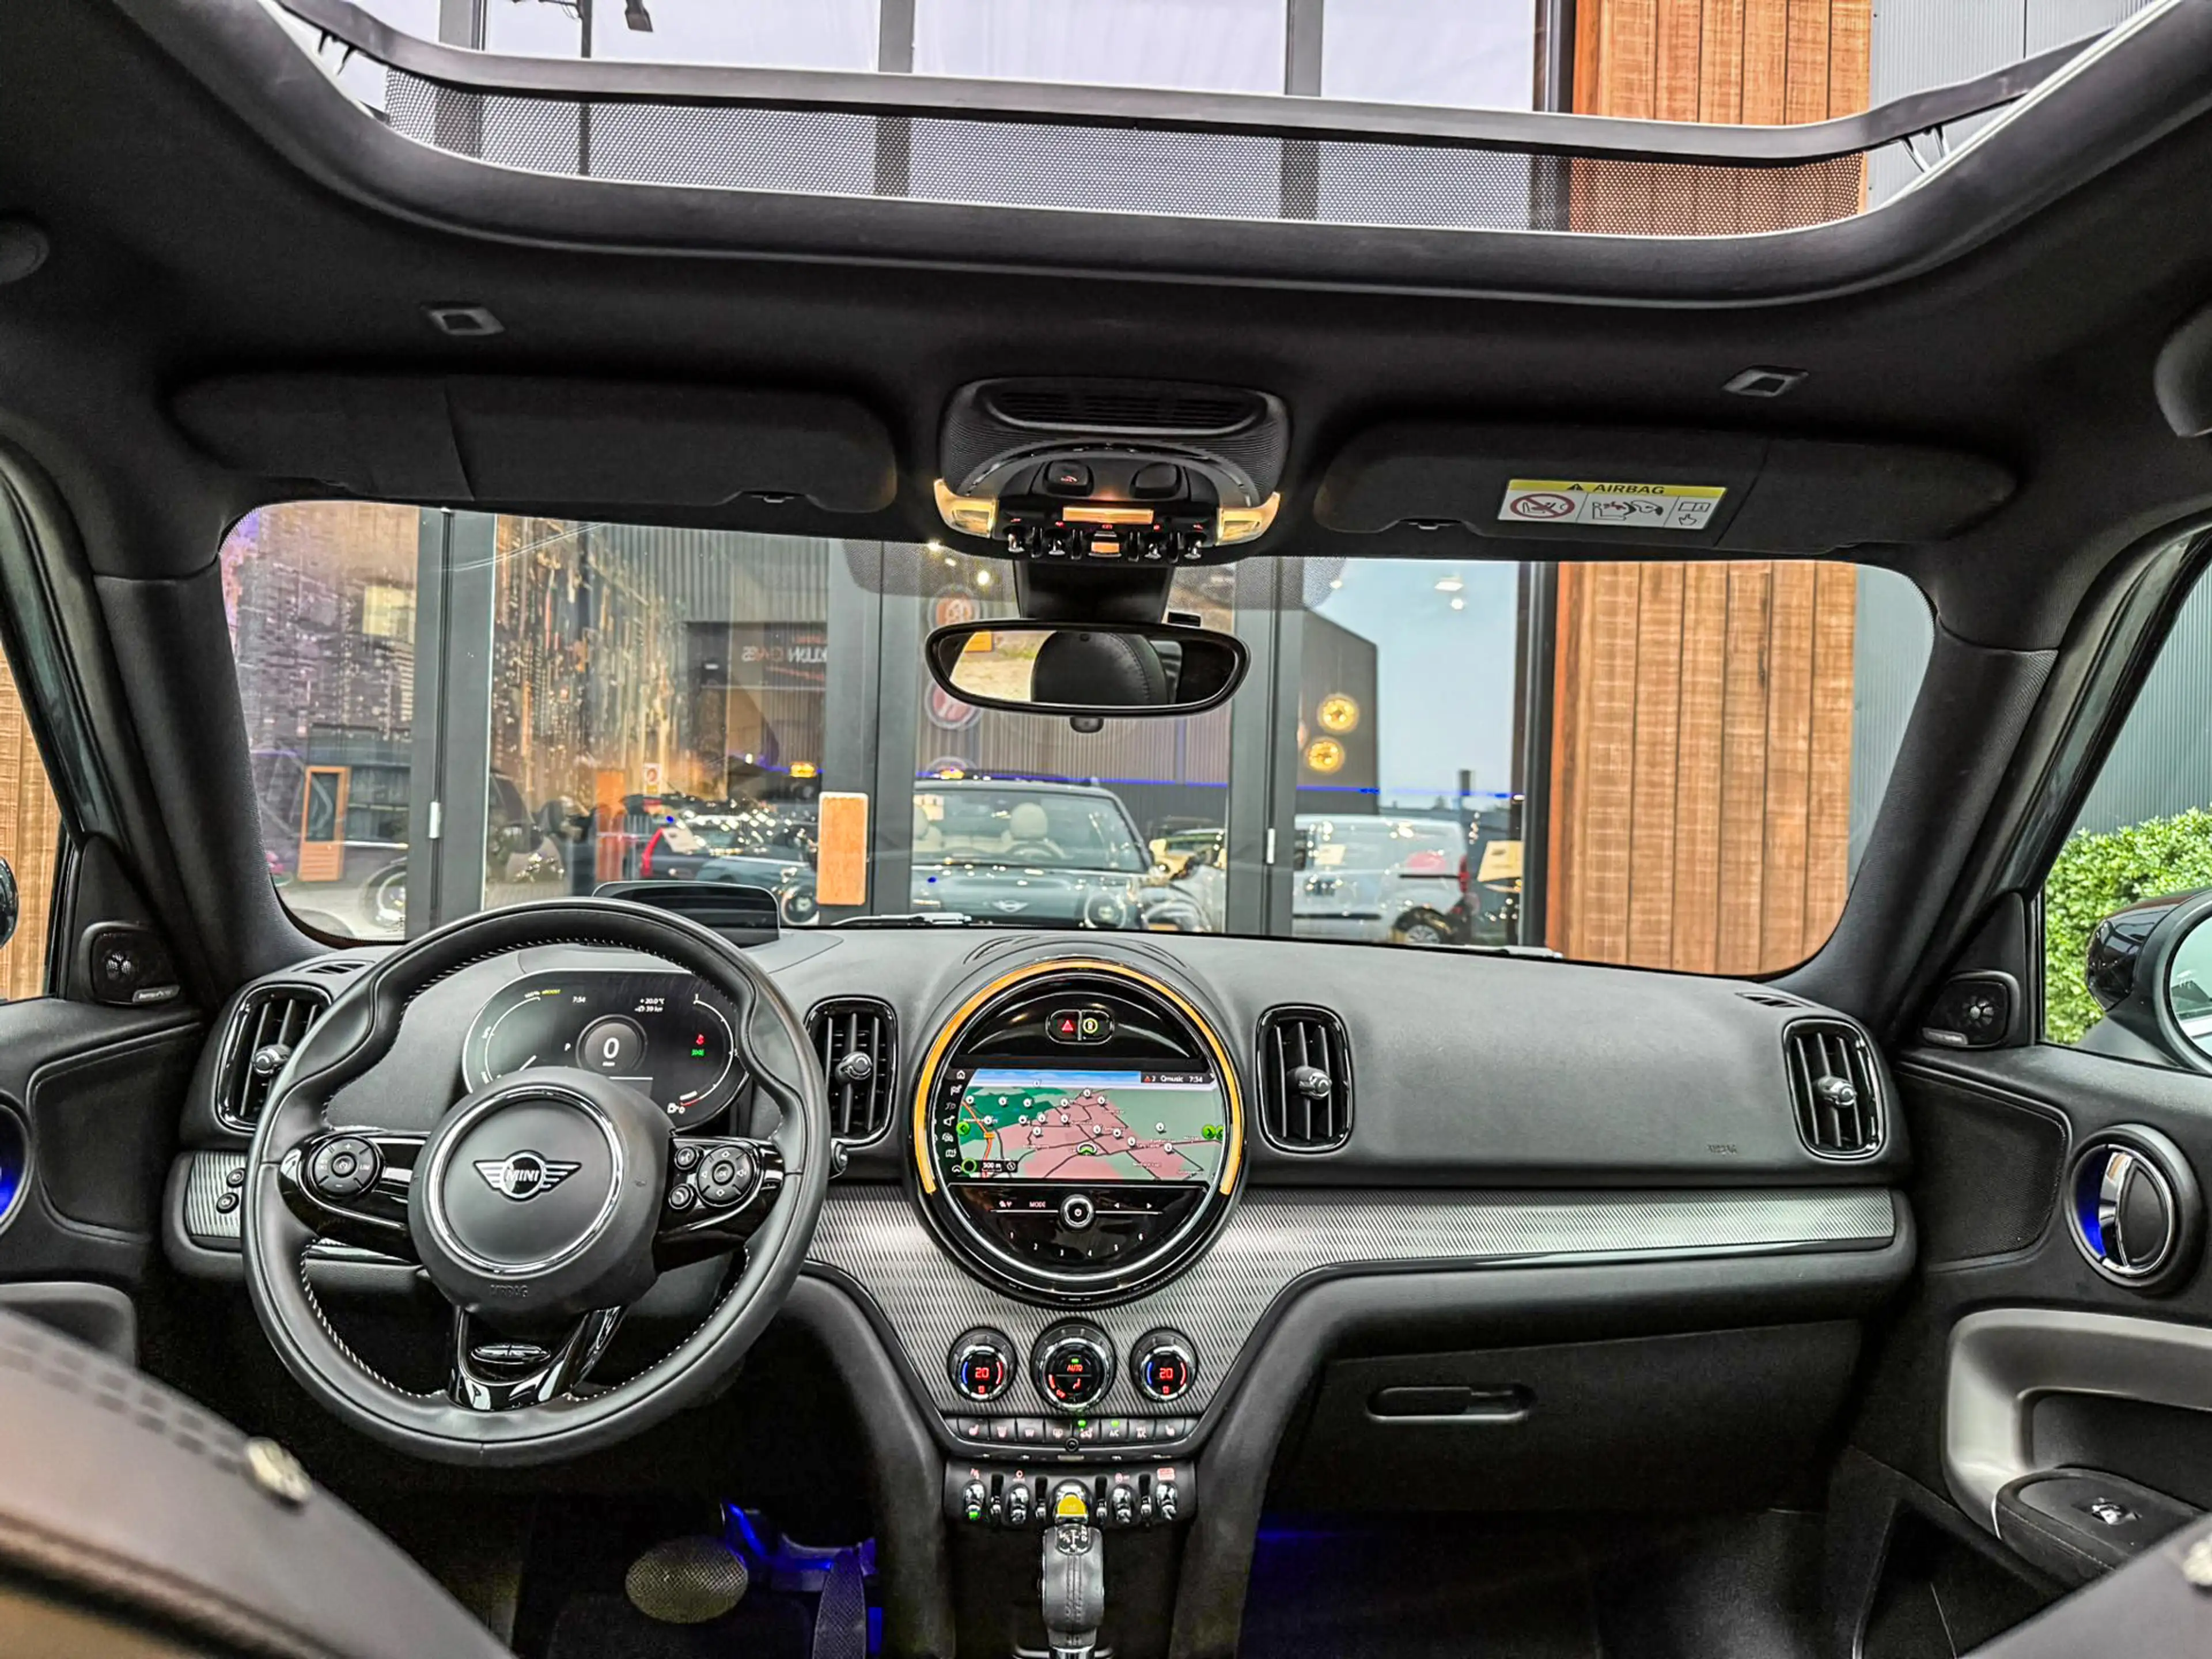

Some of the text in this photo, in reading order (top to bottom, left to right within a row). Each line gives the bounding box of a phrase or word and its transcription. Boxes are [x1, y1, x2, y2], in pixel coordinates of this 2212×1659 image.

[1592, 483, 1665, 495] AIRBAG
[564, 1043, 571, 1052] P
[603, 1037, 620, 1059] 0
[506, 1169, 541, 1182] MINI
[1138, 1233, 1143, 1241] 6
[1033, 1243, 1038, 1251] 2
[1113, 1244, 1119, 1252] 5
[1059, 1249, 1065, 1257] 3
[974, 1367, 990, 1378] 20
[1066, 1364, 1083, 1373] AUTO
[1158, 1367, 1174, 1379] 20
